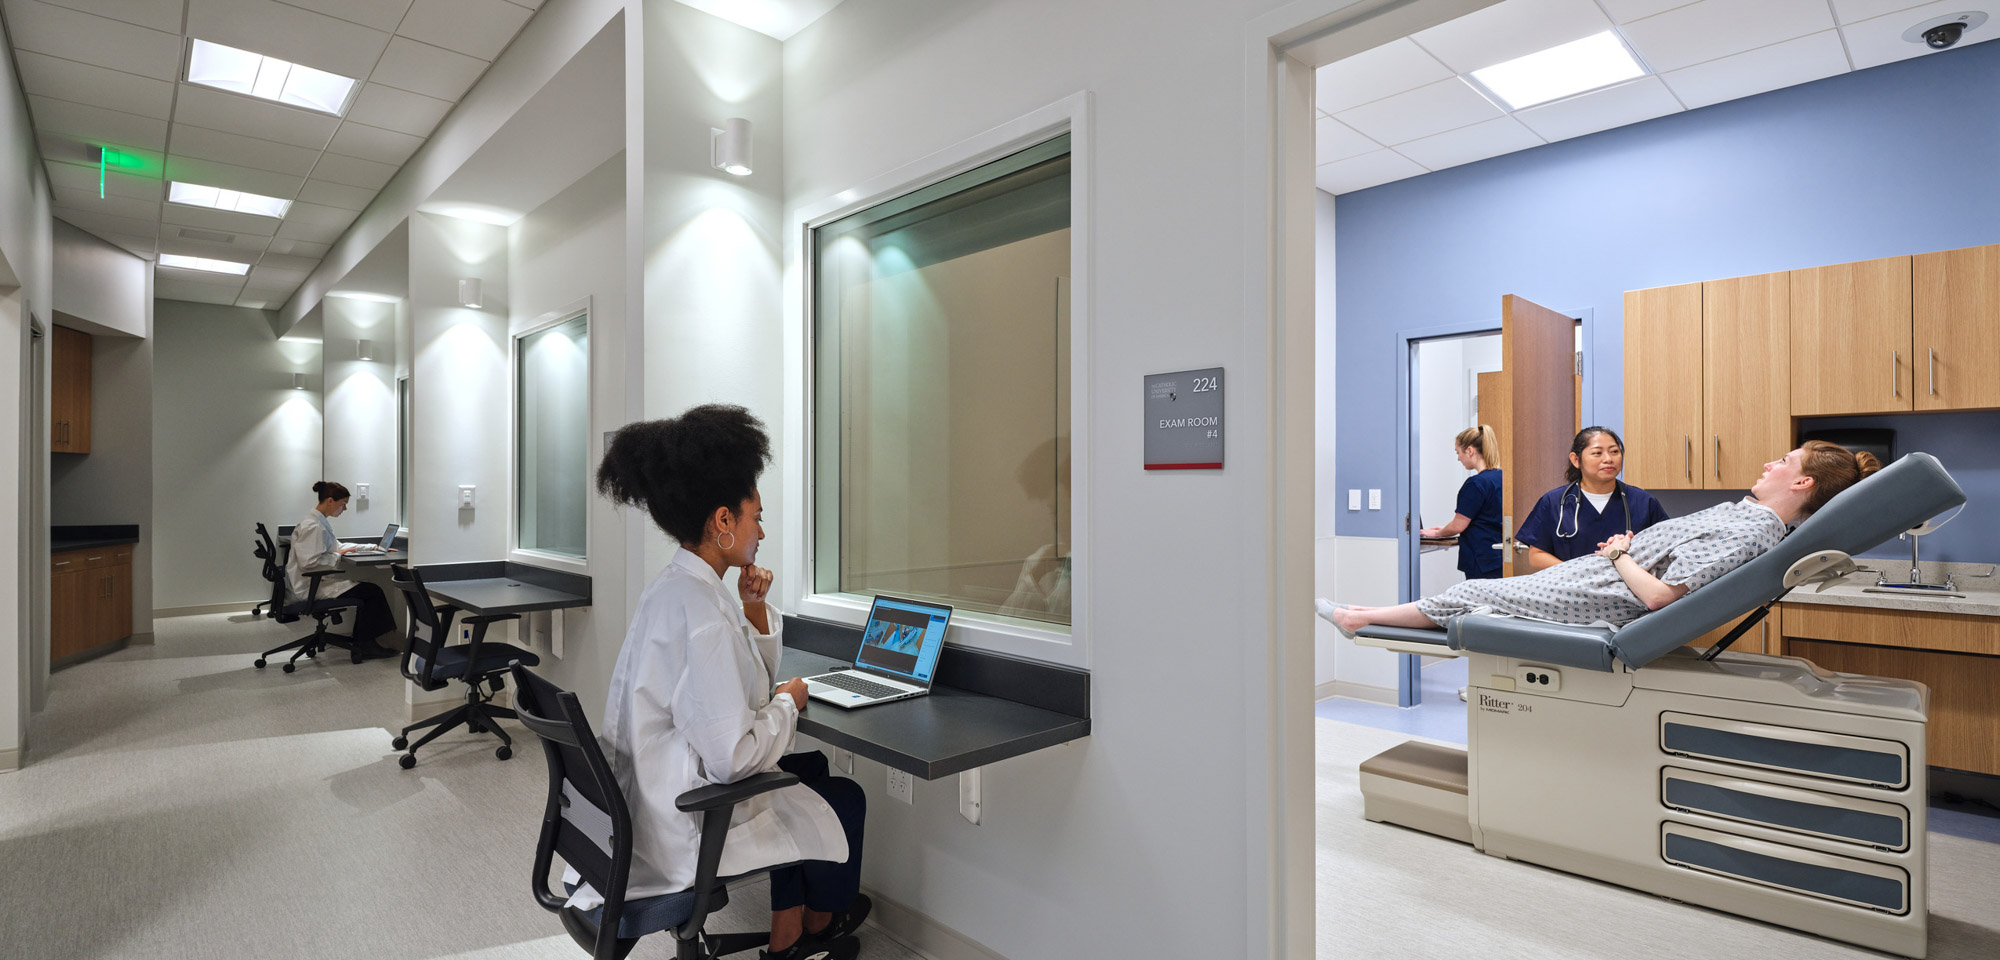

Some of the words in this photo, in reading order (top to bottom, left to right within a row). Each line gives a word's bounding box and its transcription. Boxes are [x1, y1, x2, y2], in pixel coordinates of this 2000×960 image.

[1193, 377, 1217, 392] 224
[1160, 418, 1185, 428] EXAM
[1187, 417, 1218, 427] ROOM
[1206, 429, 1218, 438] #4
[1479, 694, 1510, 709] Ritter
[1517, 704, 1532, 712] 204
